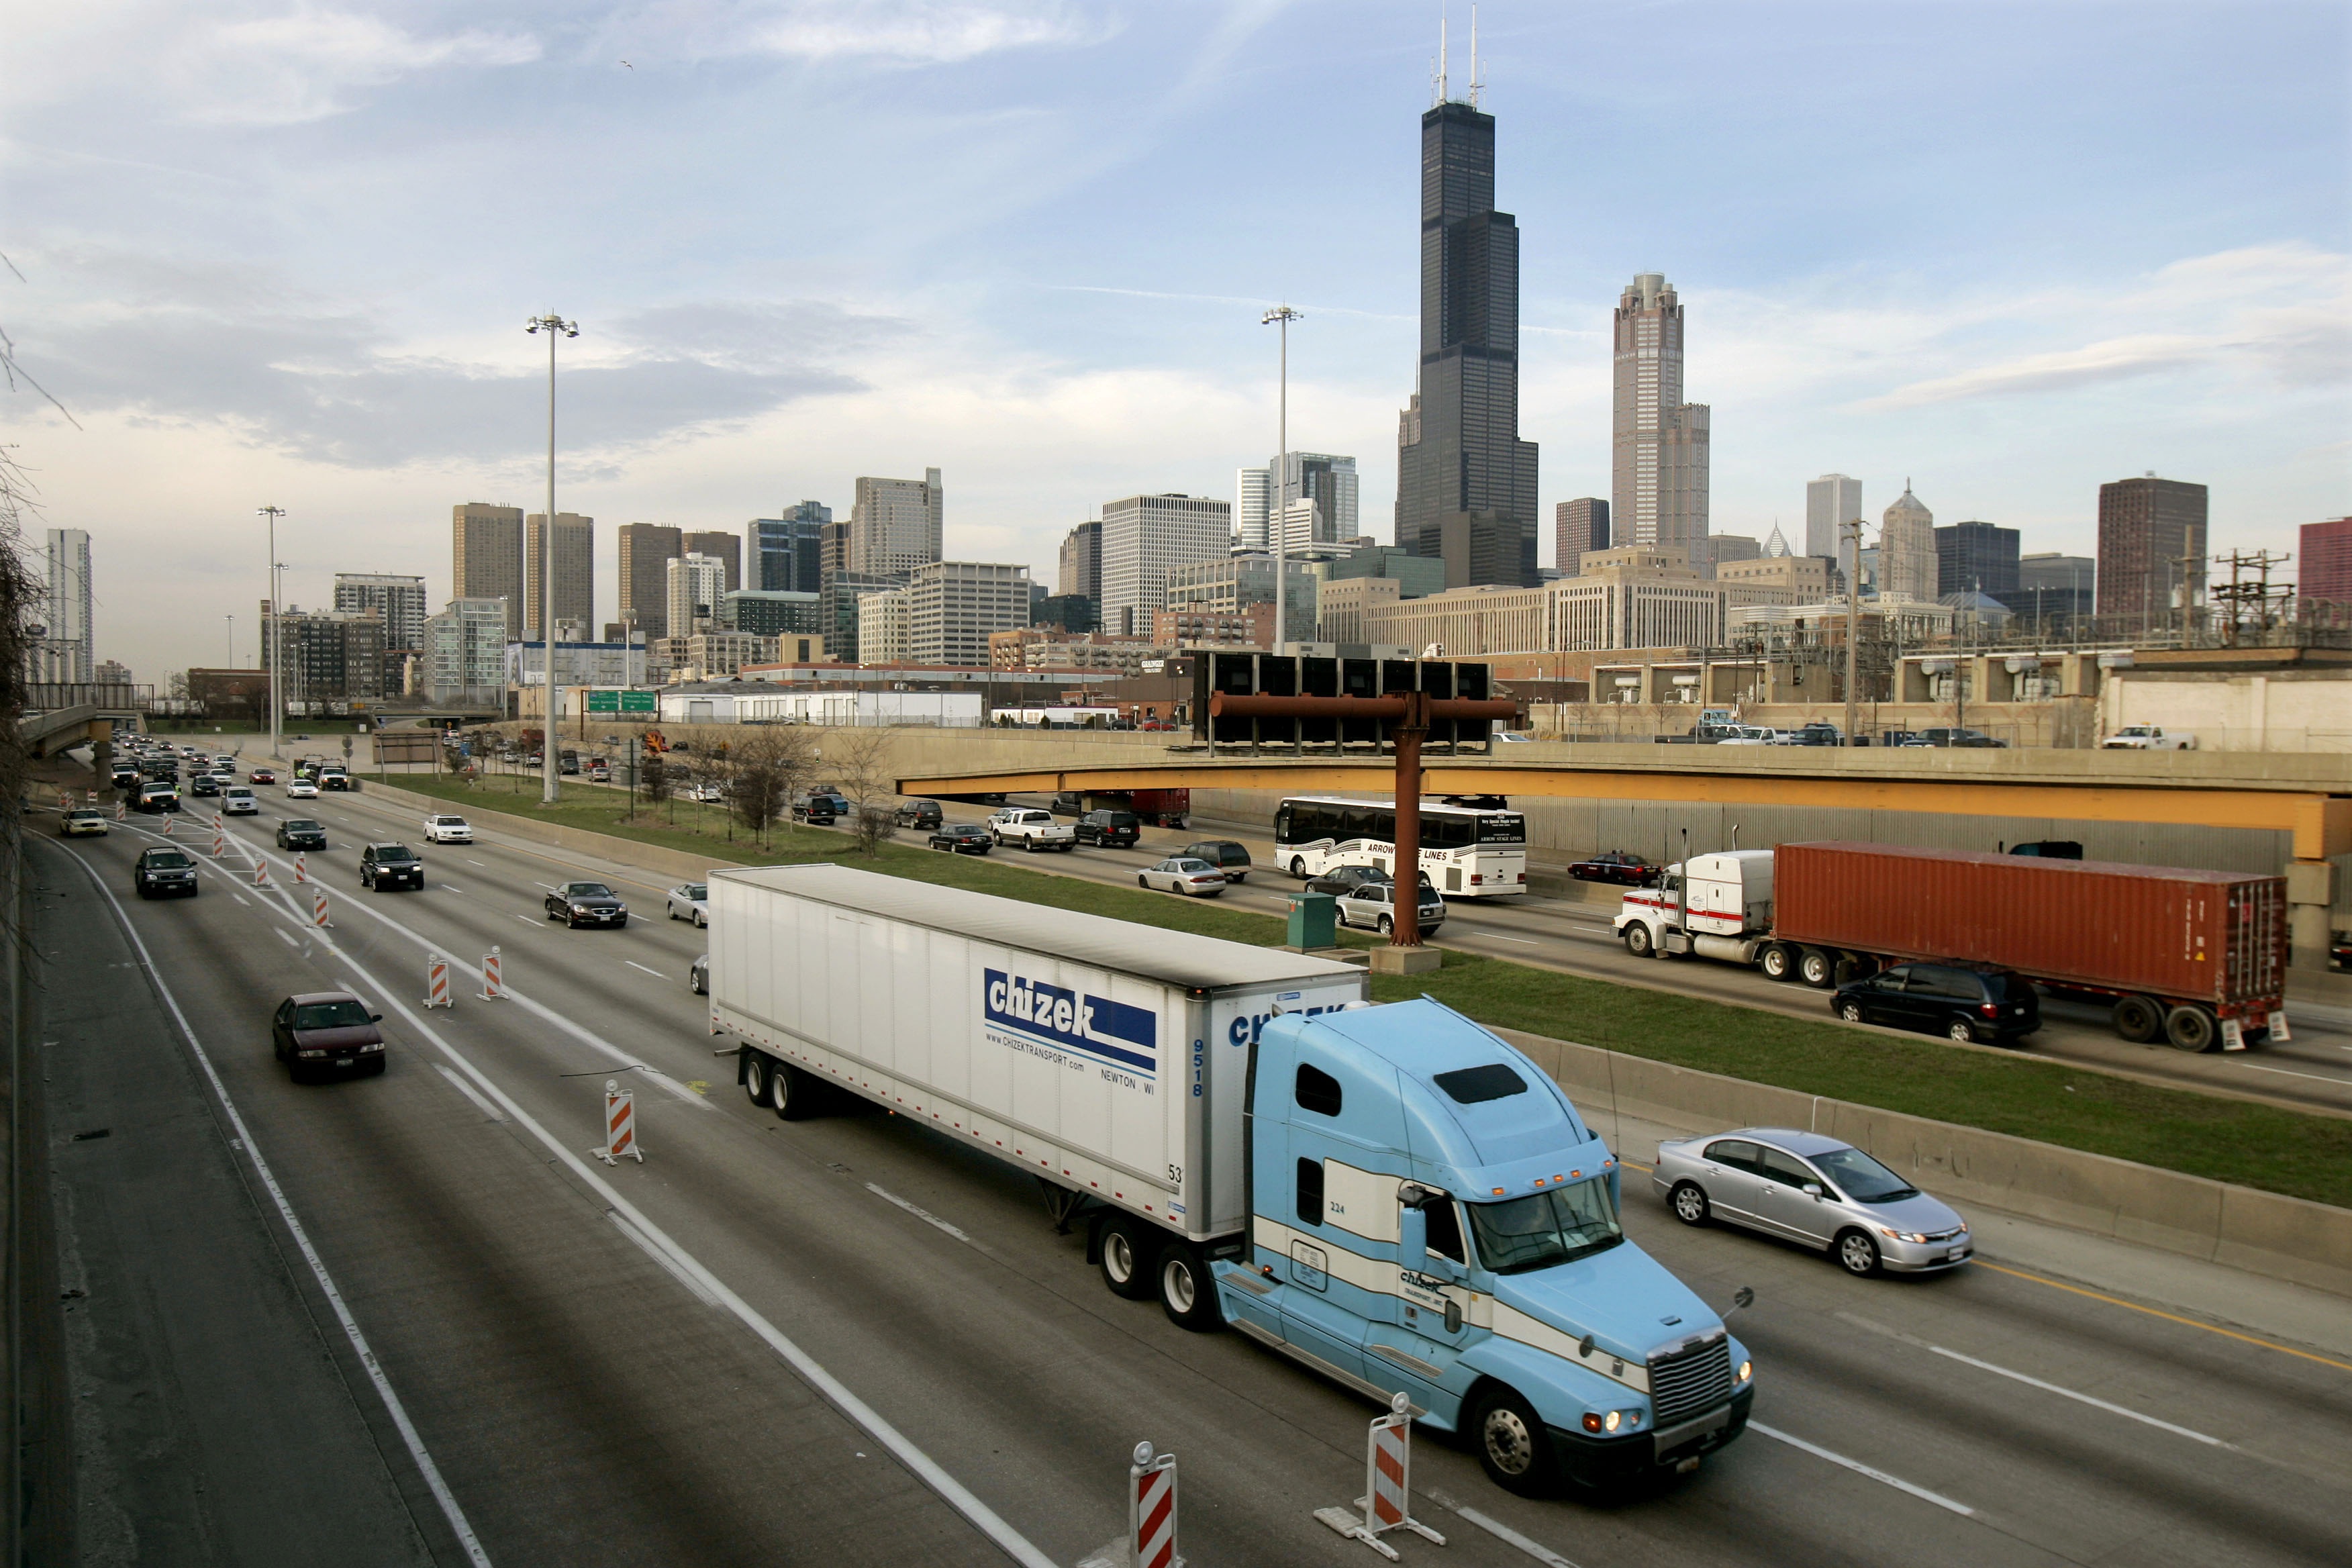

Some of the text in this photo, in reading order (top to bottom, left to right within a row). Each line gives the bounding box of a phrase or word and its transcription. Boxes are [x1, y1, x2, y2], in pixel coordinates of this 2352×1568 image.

[1368, 844, 1395, 854] ARROW
[1424, 850, 1447, 861] LINES
[989, 973, 1095, 1038] chizek
[1193, 1038, 1204, 1097] 9518
[1144, 1082, 1154, 1096] WI
[1330, 1201, 1344, 1215] 224
